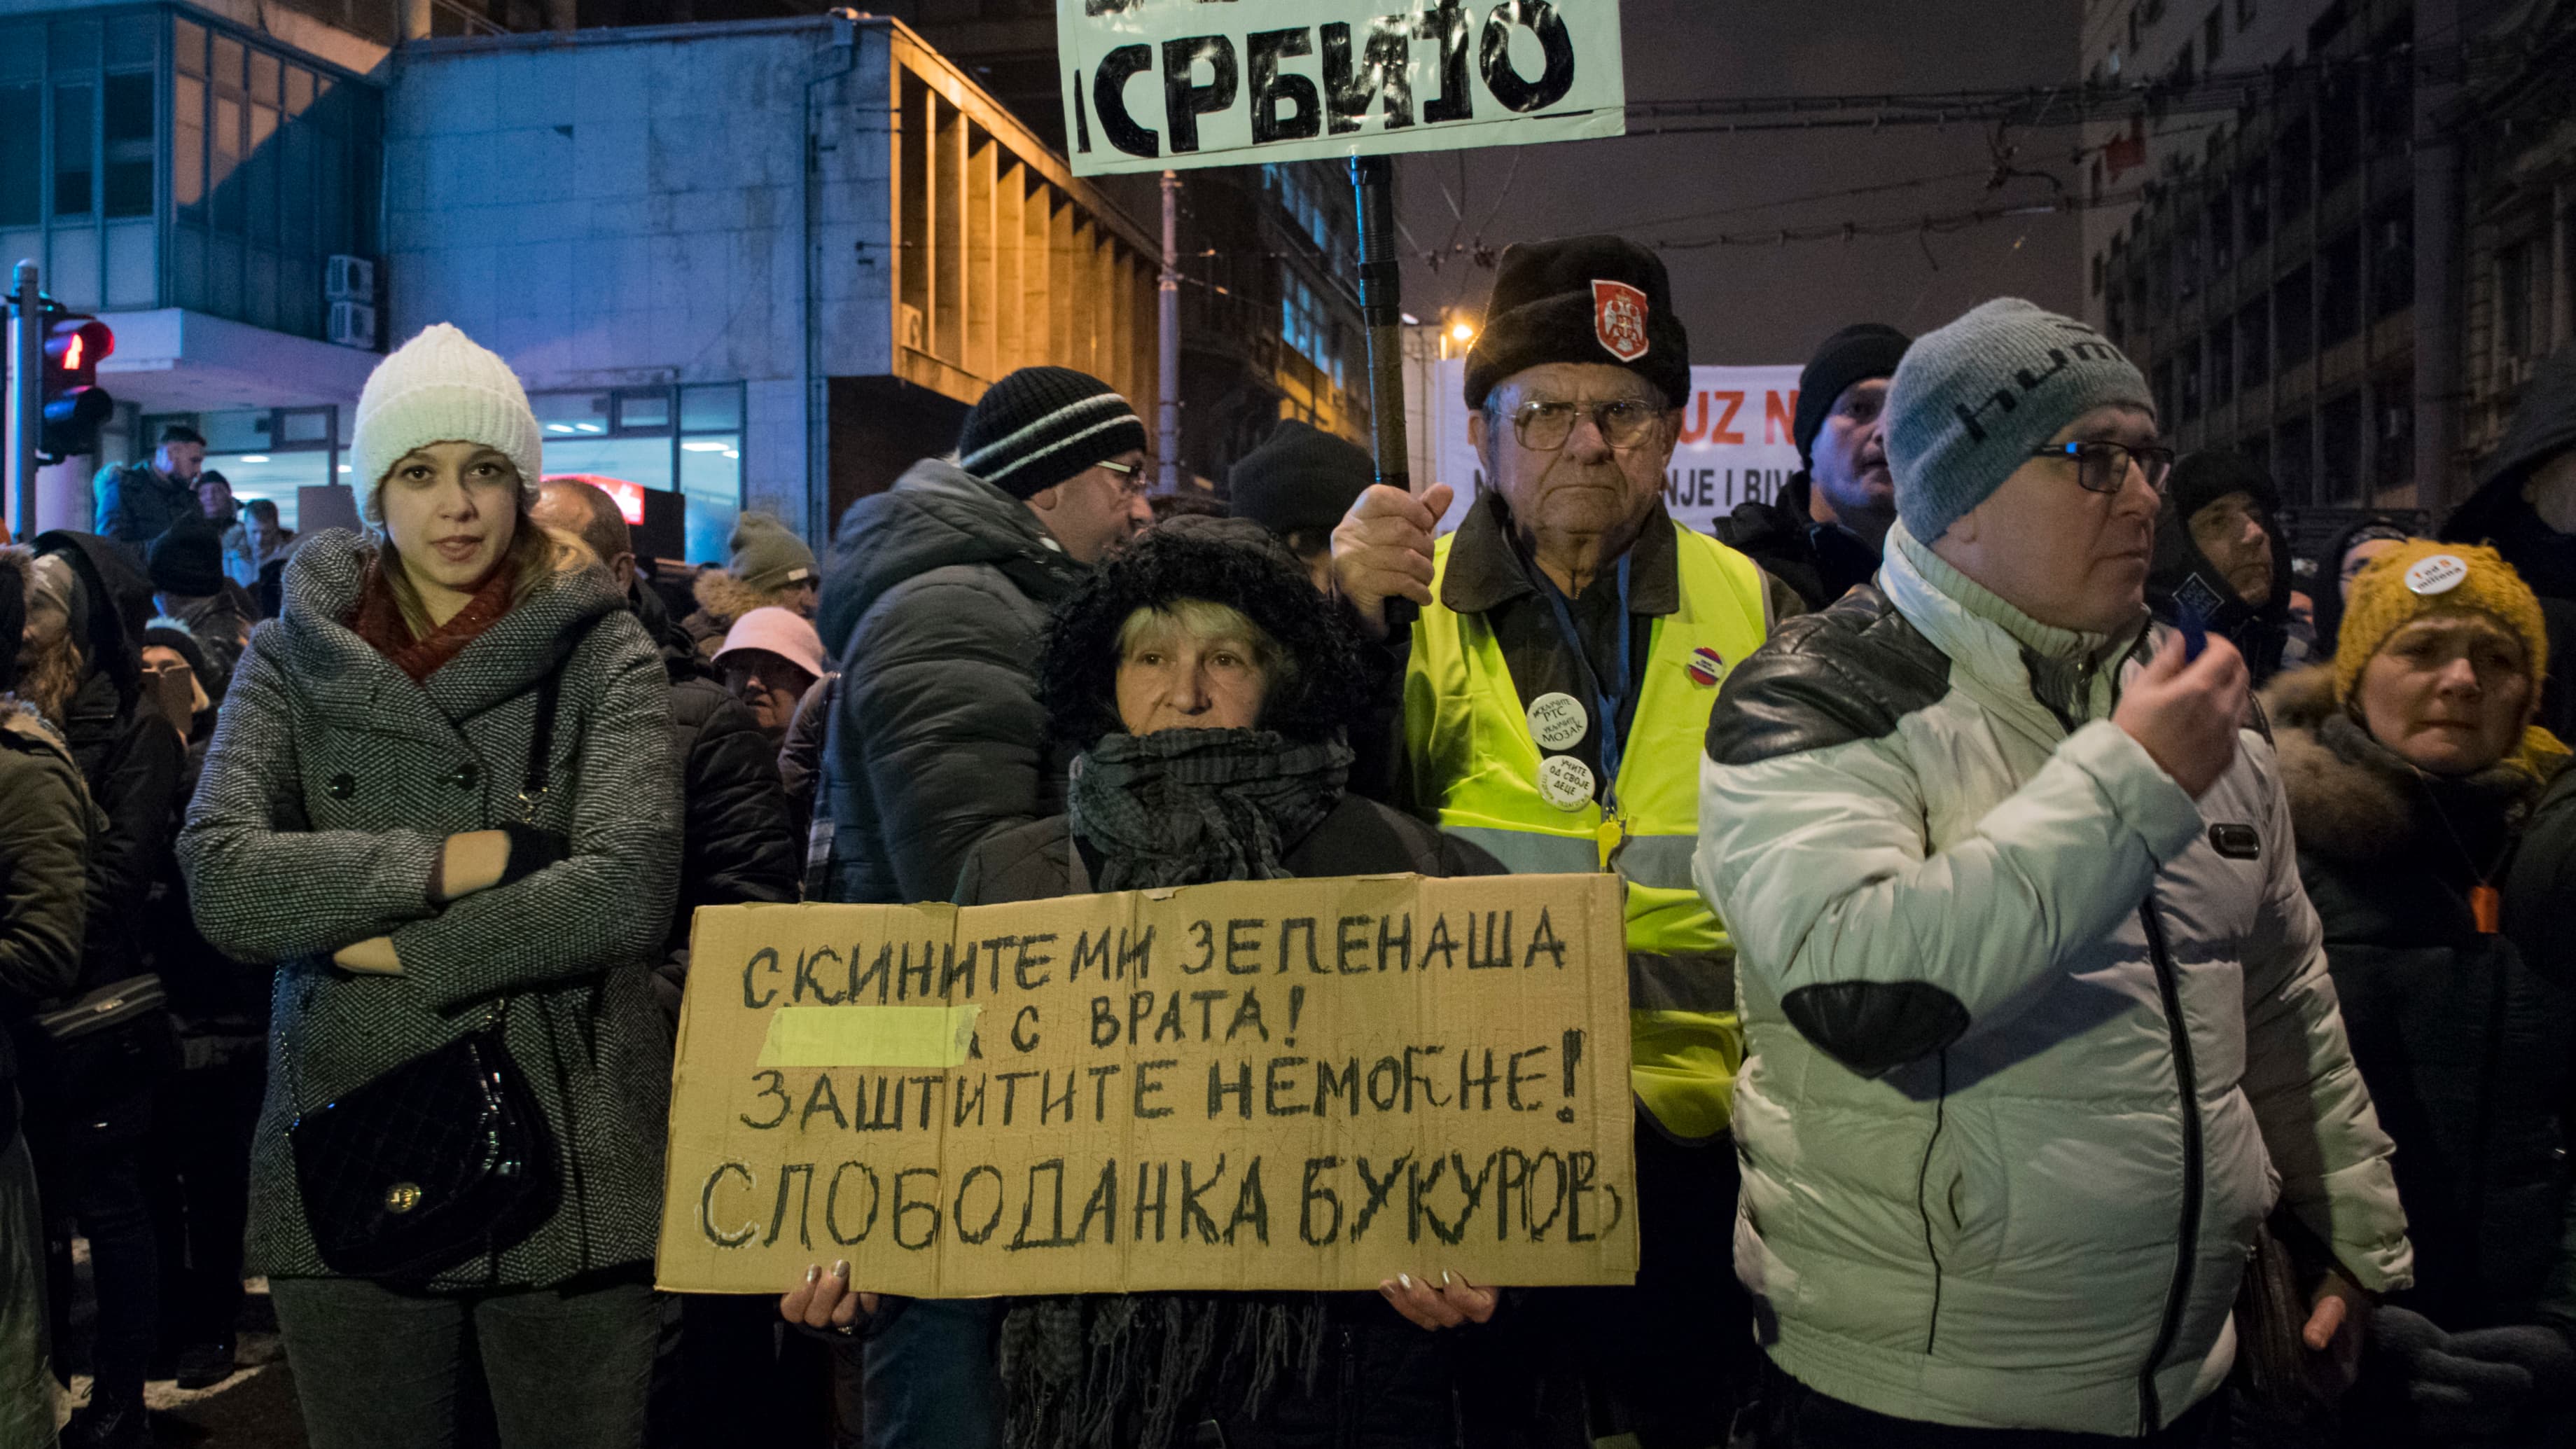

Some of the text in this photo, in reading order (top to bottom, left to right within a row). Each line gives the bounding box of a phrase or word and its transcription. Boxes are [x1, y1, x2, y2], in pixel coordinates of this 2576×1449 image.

[1543, 705, 1567, 722] РТС
[1542, 720, 1584, 742] МОЗАК
[1550, 765, 1561, 777] ОД
[1564, 772, 1589, 791] СВОЈЕ
[1561, 758, 1587, 777] УЧИТЕ
[1554, 780, 1575, 796] ДЕЦЕ
[743, 934, 1058, 1008] СКИНИТЕ
[1070, 924, 1156, 983] МИ
[1011, 1005, 1040, 1053] С
[1091, 985, 1305, 1049] ВРАТА!
[740, 1059, 1178, 1132] ЗАШТИТИТЕ
[701, 1152, 1269, 1252] СЛОБОДАНКА
